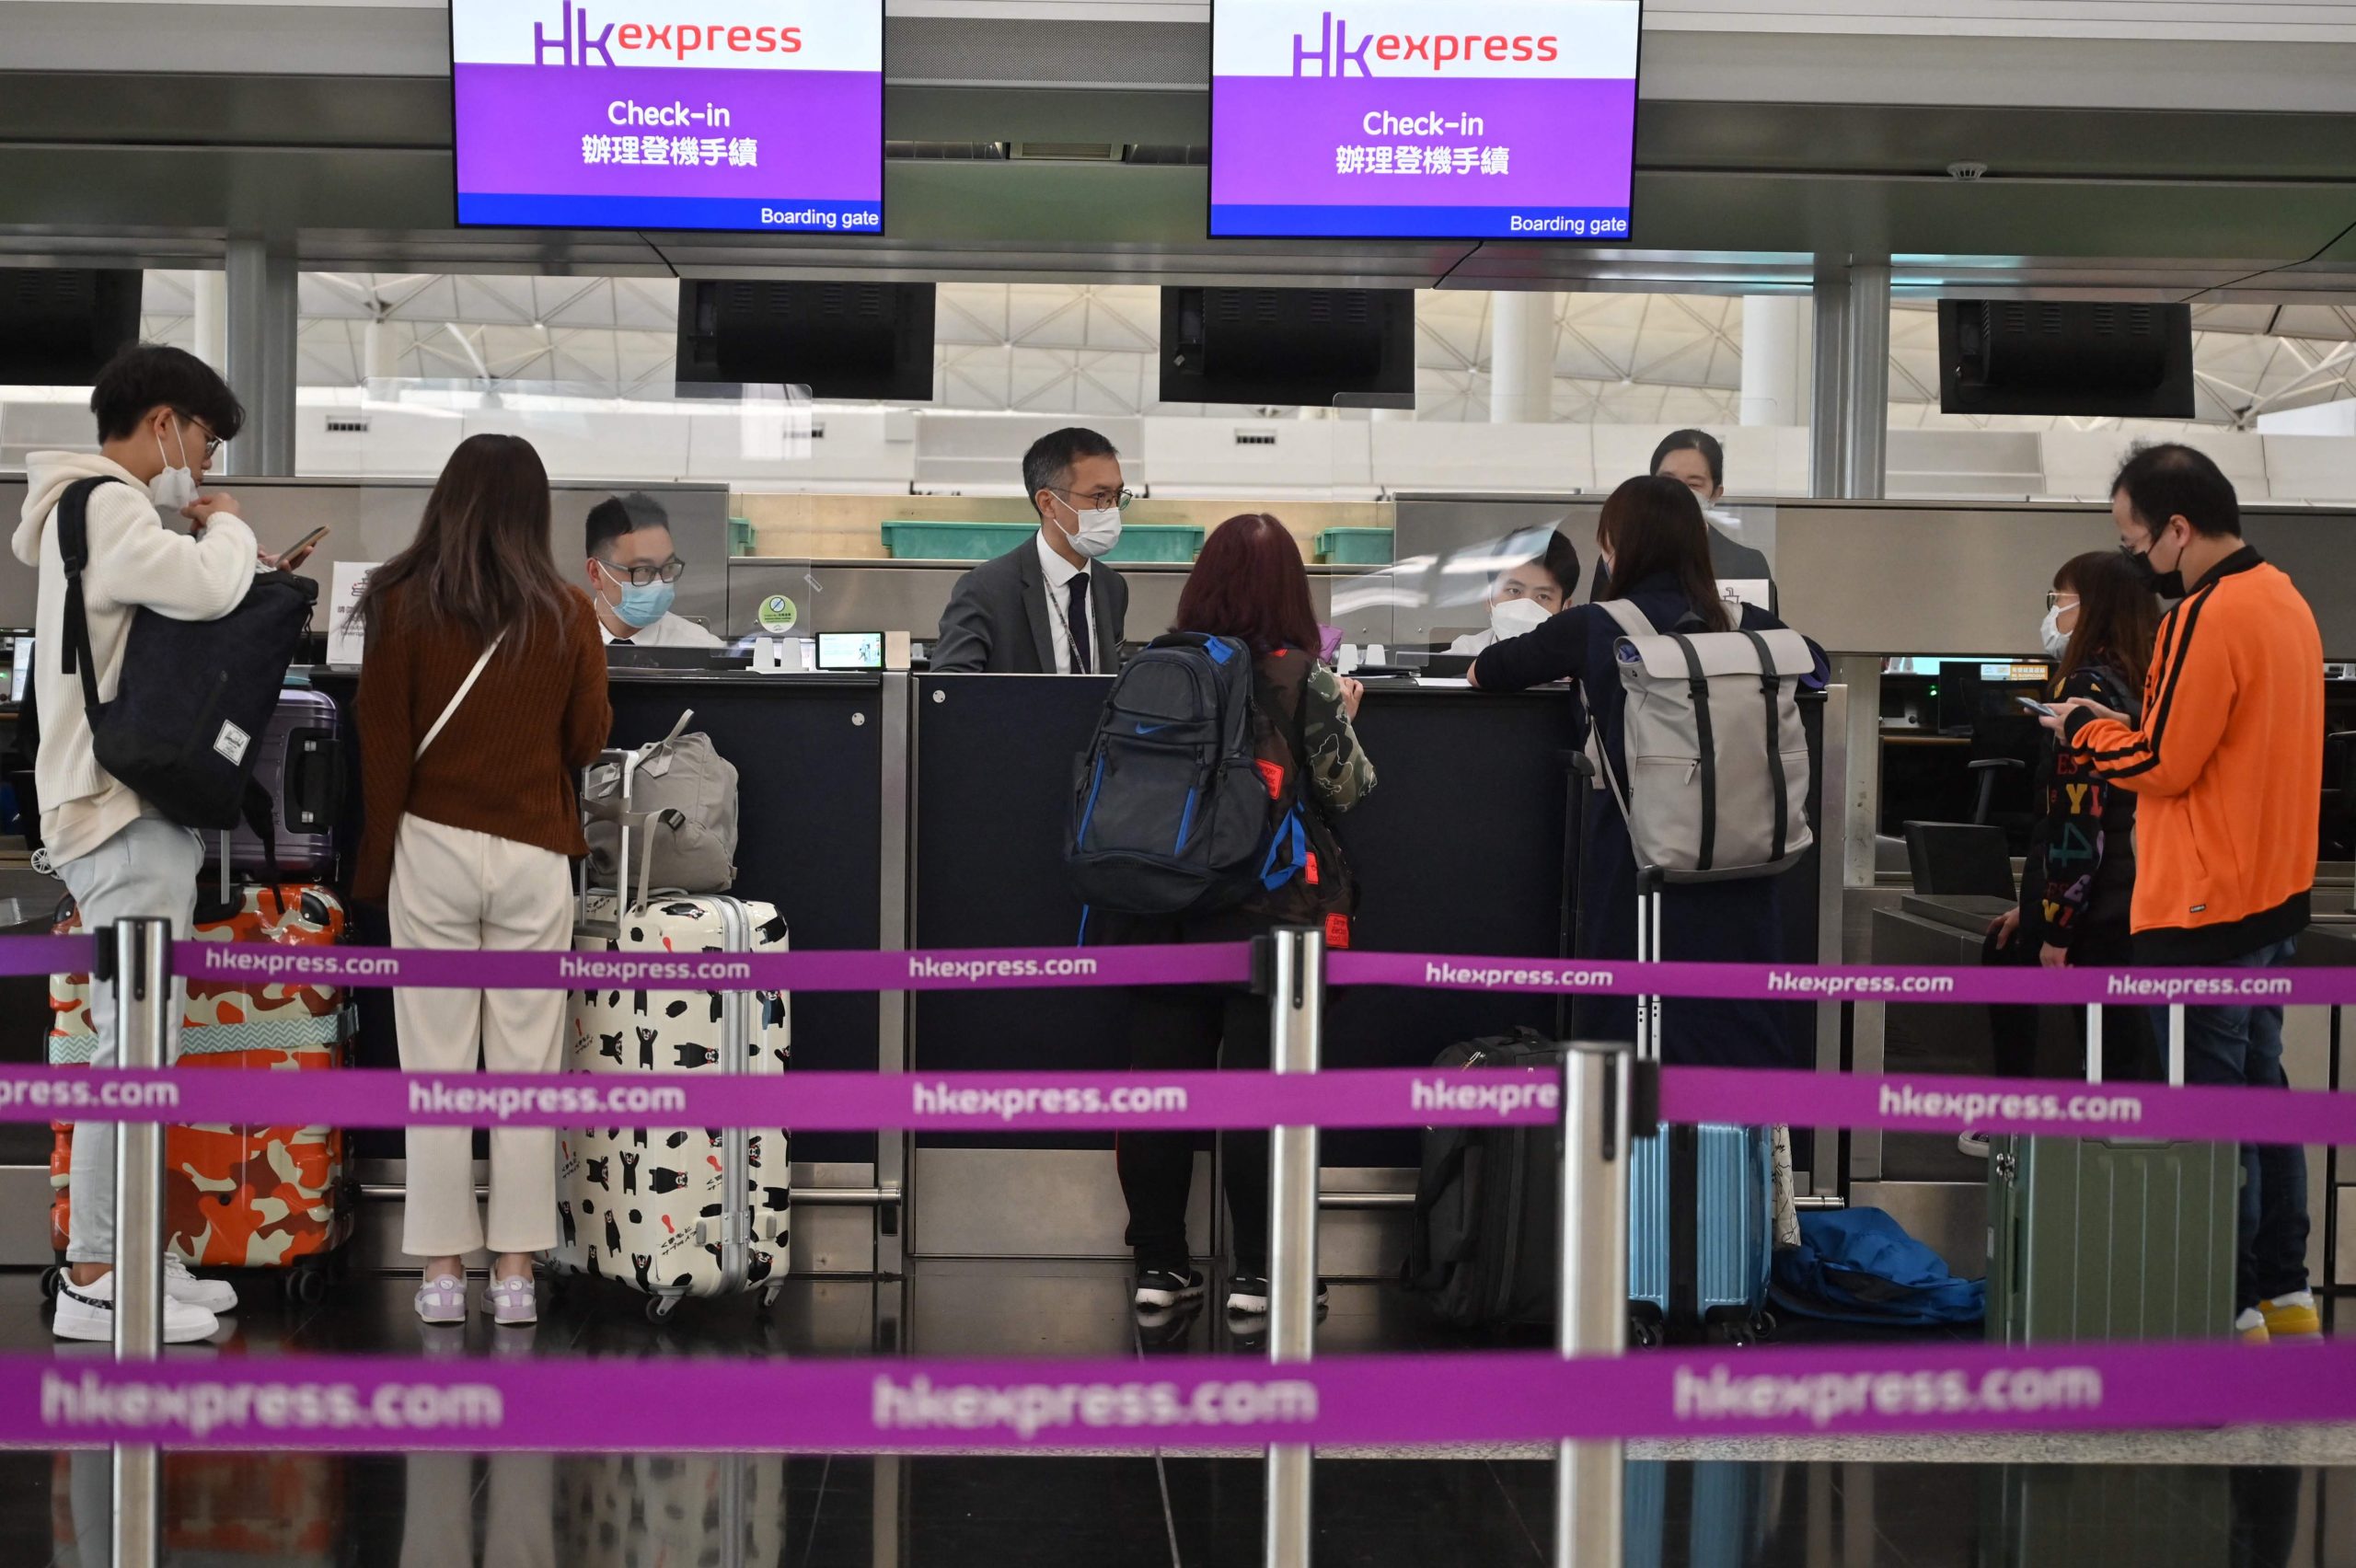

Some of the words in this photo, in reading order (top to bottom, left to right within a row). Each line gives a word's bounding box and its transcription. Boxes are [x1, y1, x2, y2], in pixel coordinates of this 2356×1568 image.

[607, 100, 731, 128] Check-in
[1362, 110, 1484, 137] Check-in
[581, 133, 758, 167] 辦理登機手續
[1335, 144, 1510, 177] 辦理登機手續
[760, 208, 837, 228] Boarding
[841, 210, 879, 229] gate
[1509, 215, 1585, 235] Boarding
[1589, 217, 1627, 236] gate
[204, 948, 400, 978] hkexpress.com
[558, 954, 751, 984] hkexpress.com
[907, 955, 1097, 981] hkexpress.com
[1425, 962, 1613, 987] hkexpress.com
[1767, 971, 1955, 996] hkexpress.com
[2107, 973, 2292, 998] hkexpress.com
[408, 1079, 687, 1121] hkexpress.com
[912, 1081, 1187, 1121] hkexpress.com
[1878, 1082, 2142, 1124] hkexpress.com
[40, 1370, 503, 1436] hkexpress.com
[872, 1371, 1319, 1439] hkexpress.com
[1672, 1364, 2102, 1426] hkexpress.com
